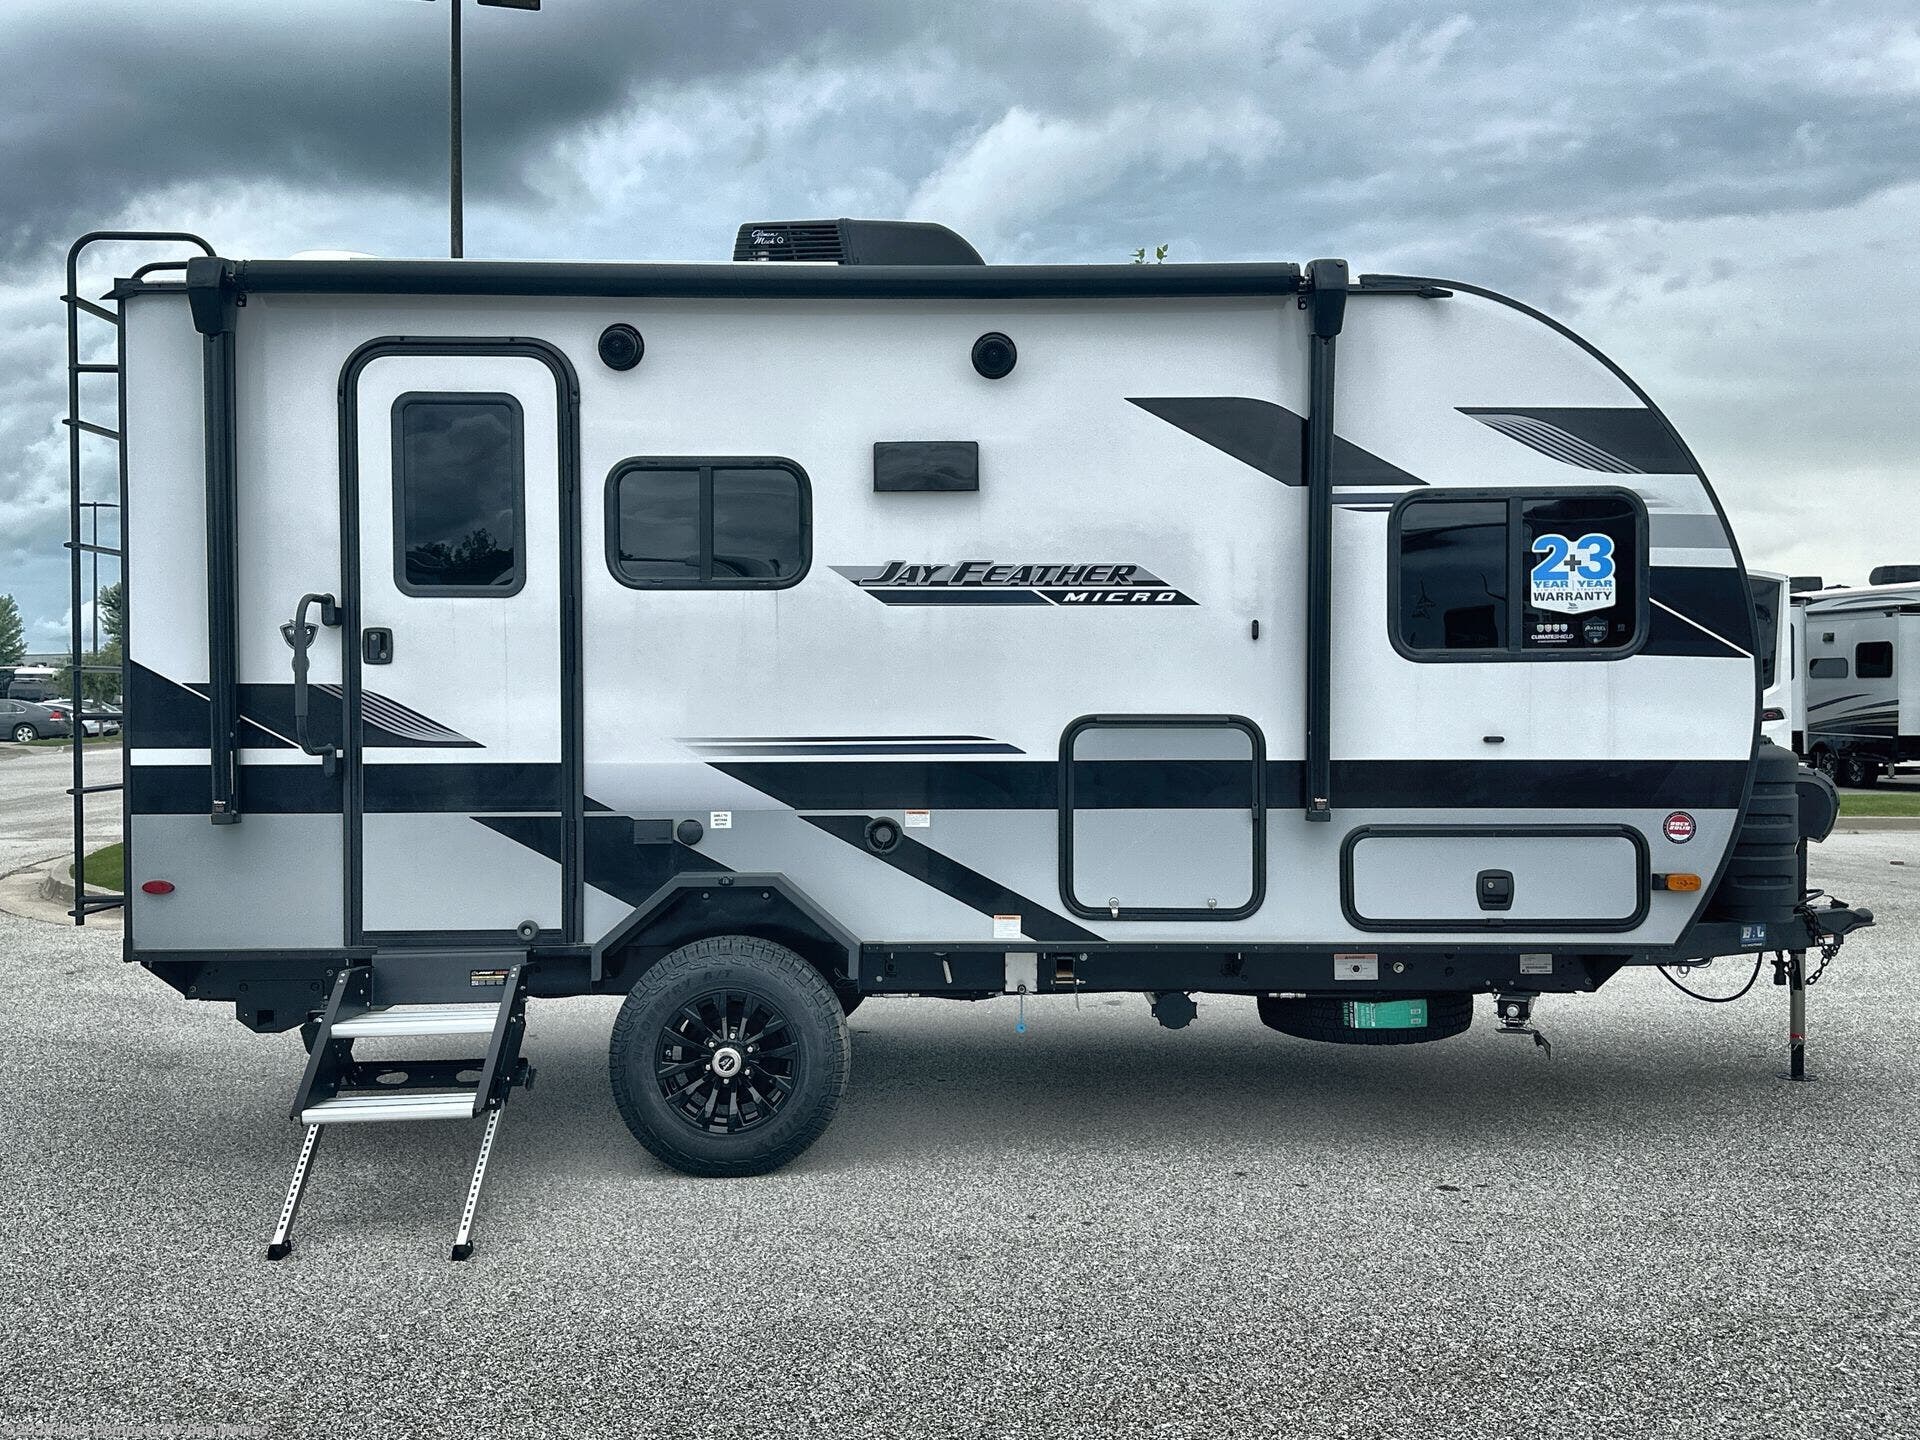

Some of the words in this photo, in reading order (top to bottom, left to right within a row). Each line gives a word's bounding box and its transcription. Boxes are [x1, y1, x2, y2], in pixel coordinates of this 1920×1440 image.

[859, 560, 948, 586] JAY
[947, 560, 1141, 586] FEATHER
[1533, 580, 1569, 588] YEAR
[1577, 580, 1613, 588] YEAR
[1061, 591, 1177, 603] MICRO
[1533, 591, 1613, 601] WARRANTY
